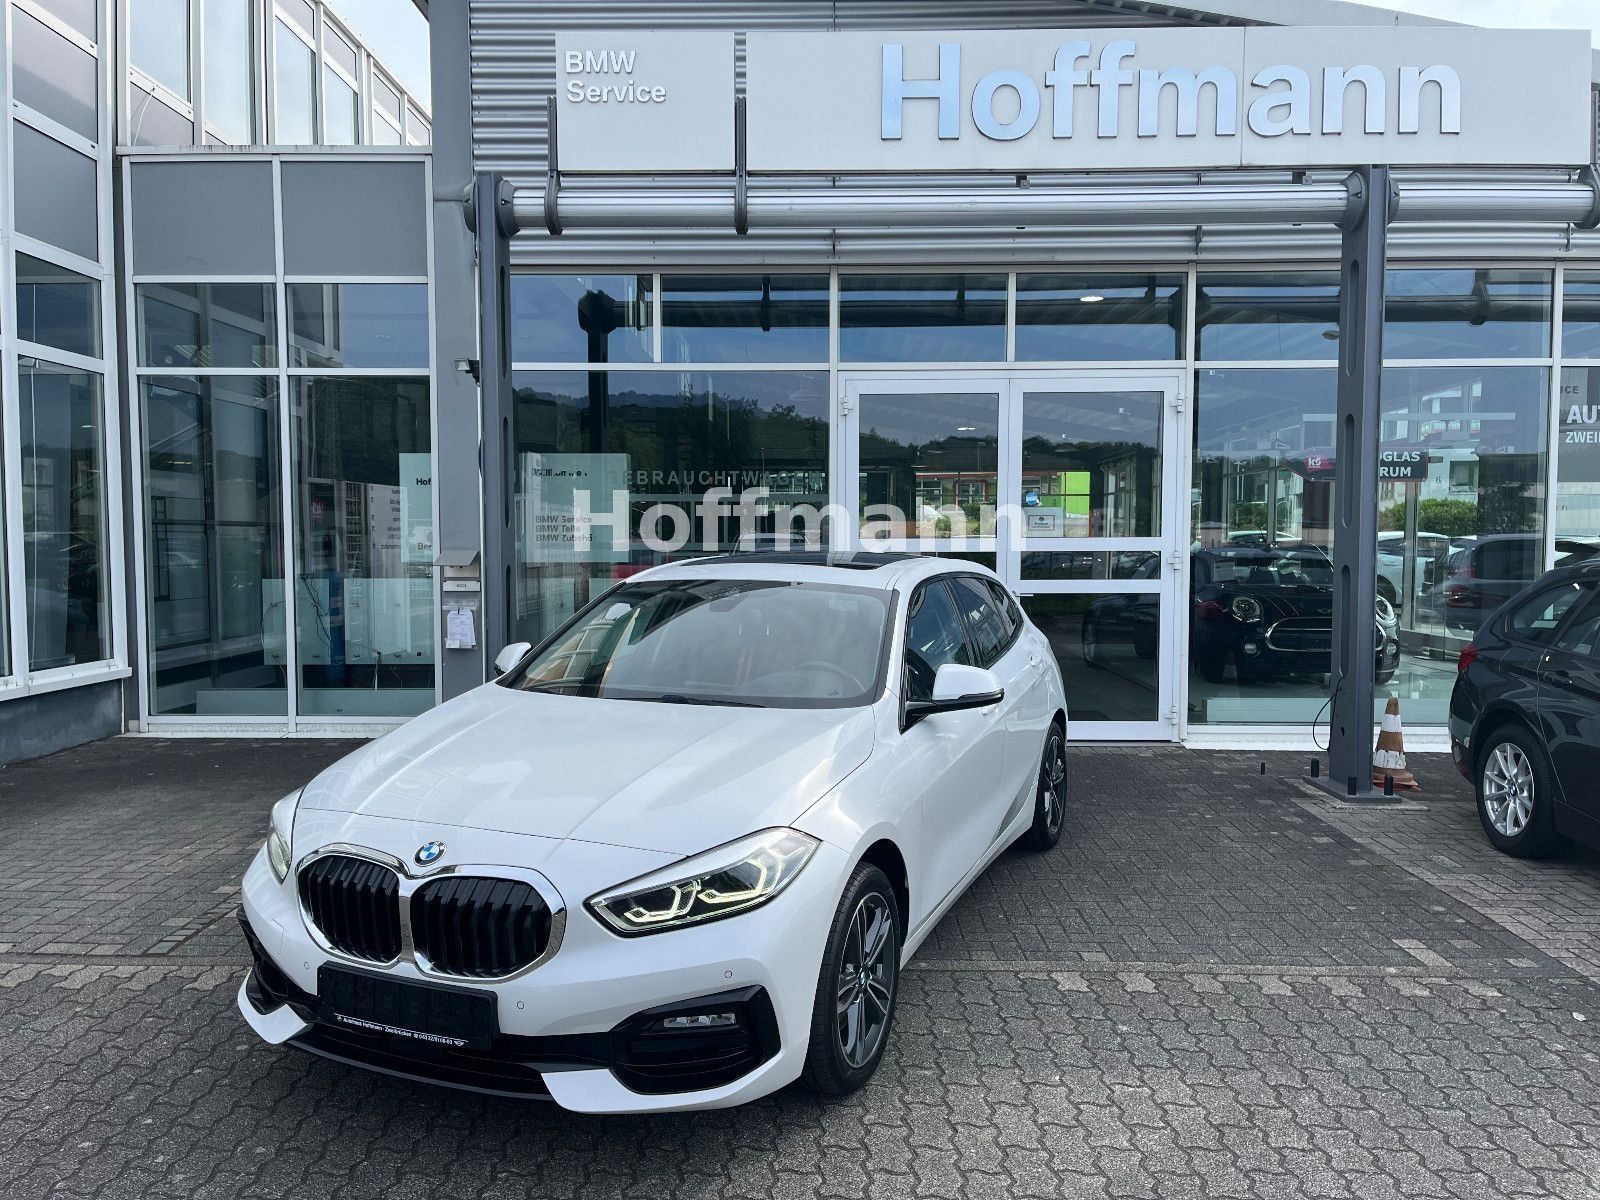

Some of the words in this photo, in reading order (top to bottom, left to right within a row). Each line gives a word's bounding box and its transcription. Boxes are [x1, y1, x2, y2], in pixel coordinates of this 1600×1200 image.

[565, 50, 636, 74] BMW
[566, 80, 667, 104] Service
[880, 40, 1461, 141] Hoffmann
[1565, 431, 1600, 443] ZWEI
[536, 515, 559, 524] BMW
[561, 515, 593, 524] Service
[536, 525, 559, 533] BMW
[536, 534, 559, 542] BMW
